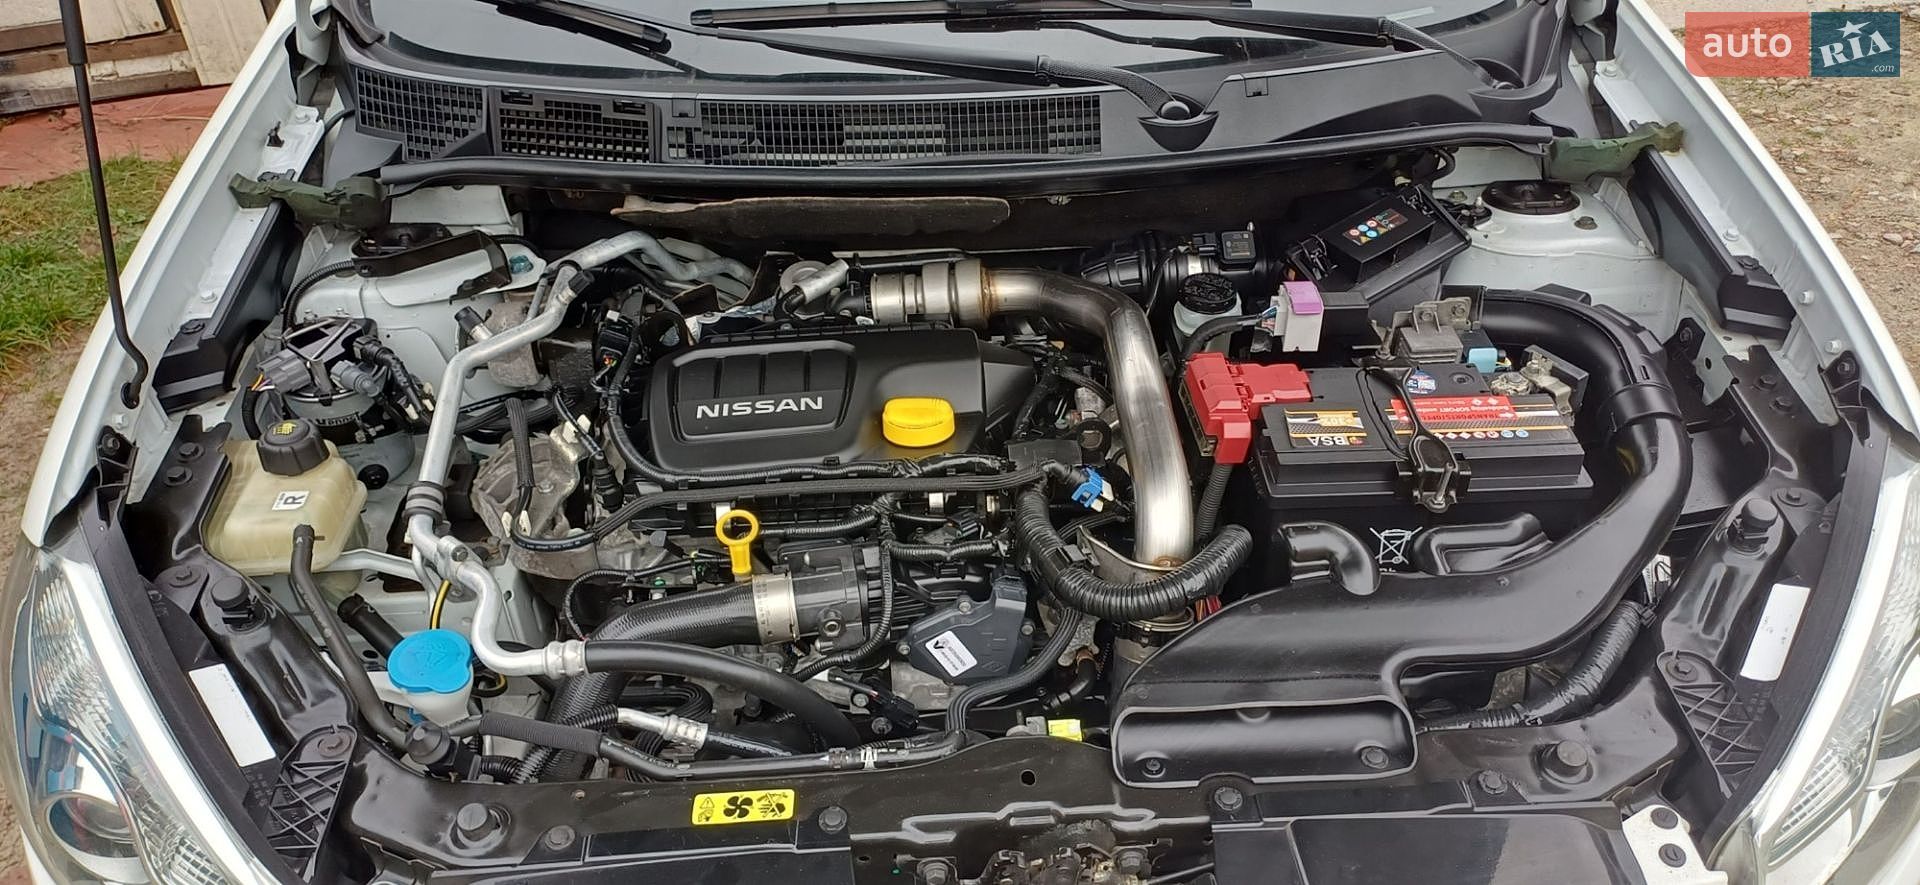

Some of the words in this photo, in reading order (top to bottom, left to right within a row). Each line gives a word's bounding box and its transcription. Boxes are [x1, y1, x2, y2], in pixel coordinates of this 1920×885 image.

[696, 396, 823, 419] NISSAN
[1307, 436, 1350, 446] BSA
[283, 495, 305, 504] R
